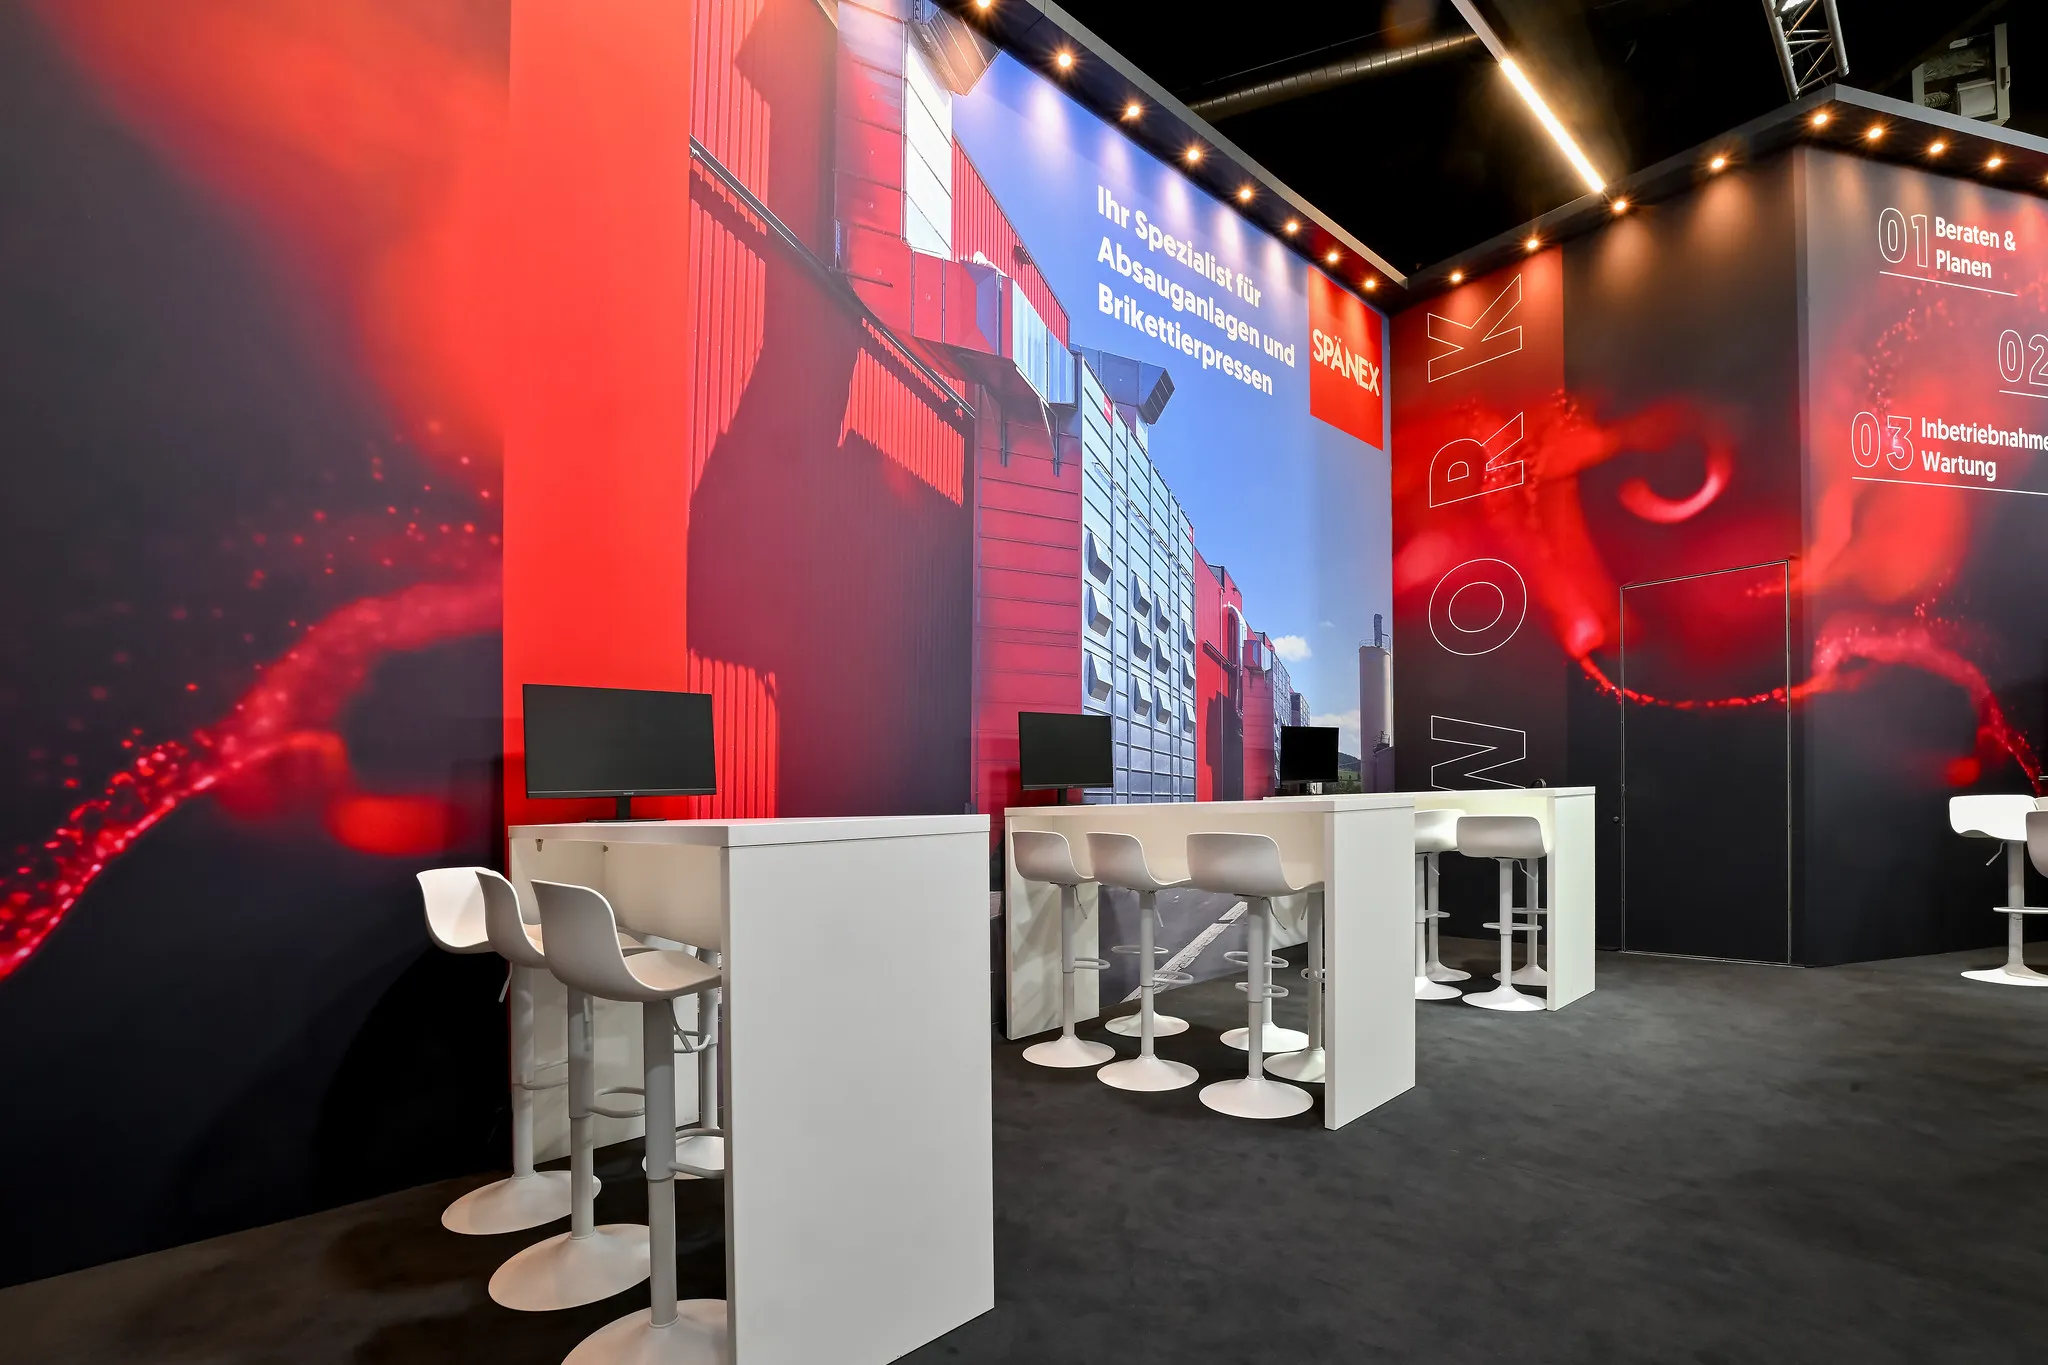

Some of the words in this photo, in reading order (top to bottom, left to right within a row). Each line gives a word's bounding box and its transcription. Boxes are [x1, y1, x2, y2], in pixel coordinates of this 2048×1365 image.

[1097, 184, 1131, 230] Ihr
[1134, 209, 1233, 293] Spezialist
[1235, 272, 1262, 309] für
[1878, 207, 1928, 268] 01
[1935, 216, 2000, 250] Beraten
[2003, 230, 2017, 252] &
[1936, 249, 1993, 279] Planen
[1097, 235, 1261, 350] Absauganlagen
[1263, 333, 1296, 369] und
[1098, 281, 1274, 397] Brikettierpressen
[1312, 327, 1380, 398] SPÄNEX
[1998, 329, 2048, 387] 02
[1851, 411, 1914, 471] 03
[1922, 450, 1997, 482] Wartung
